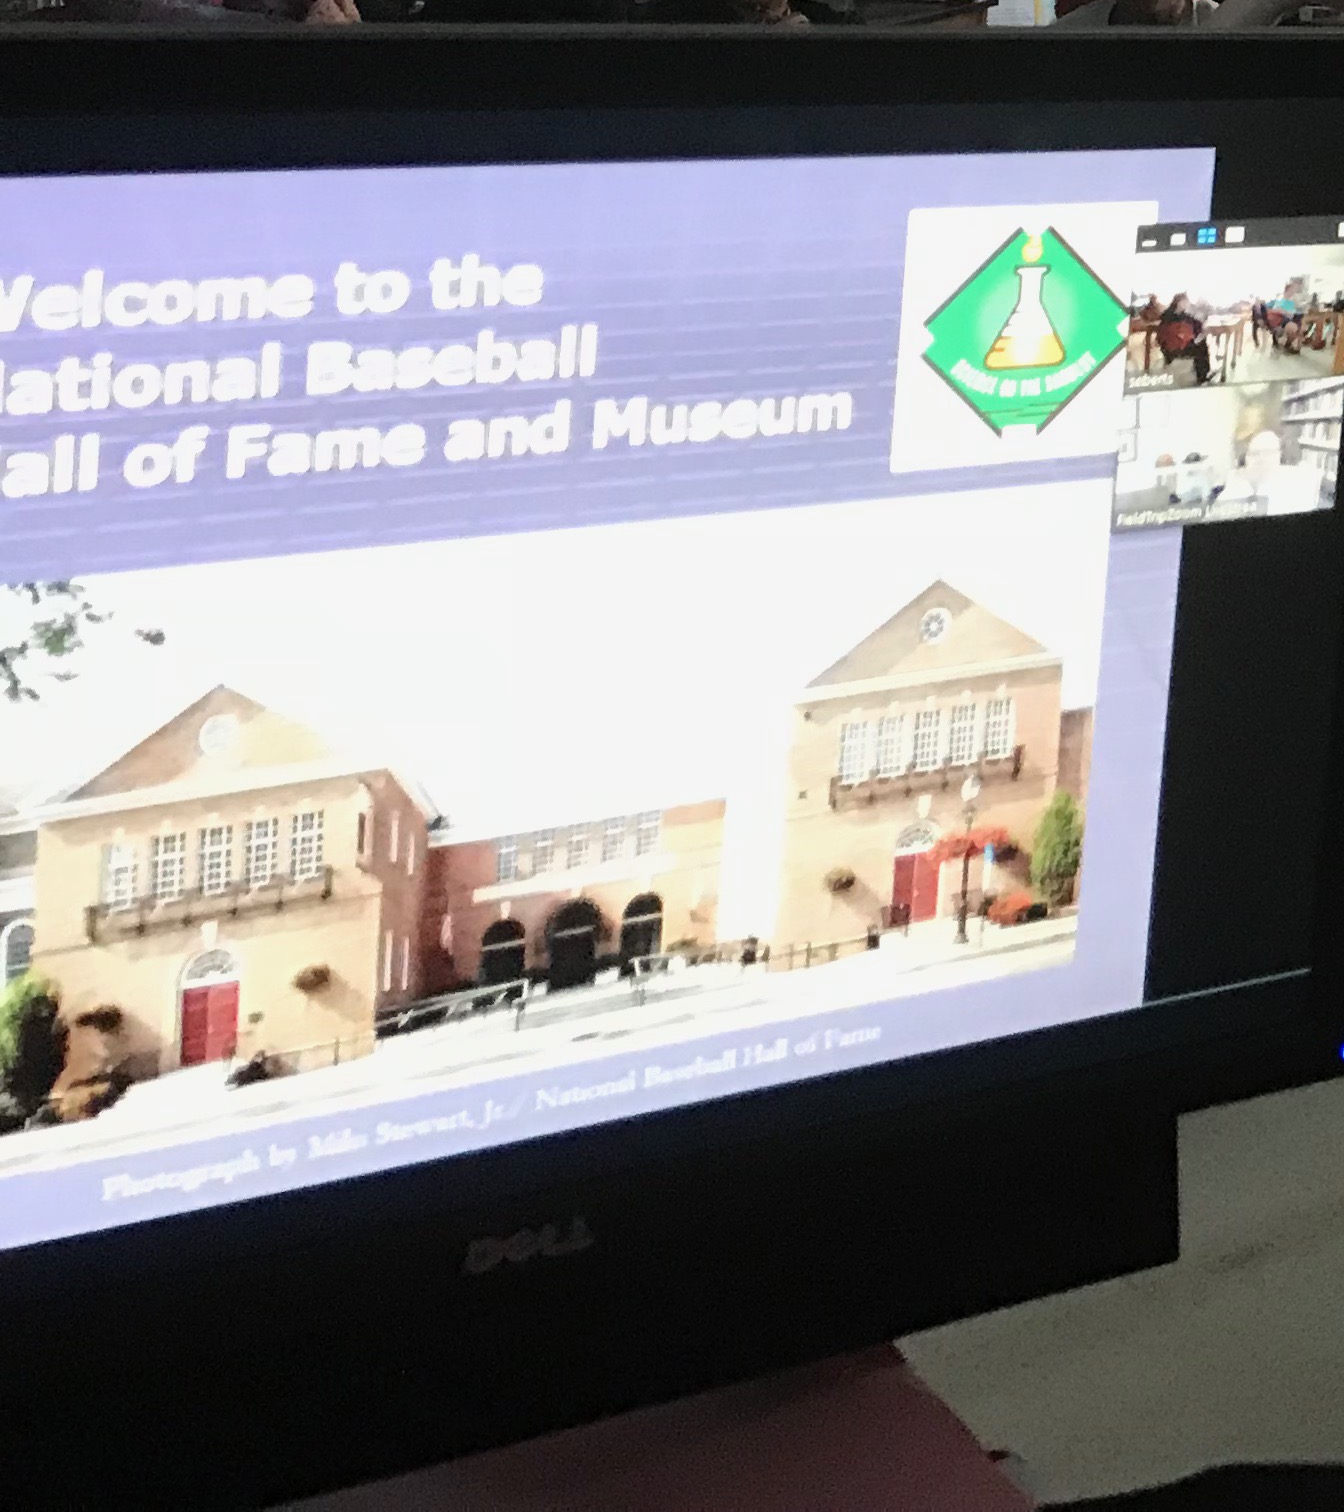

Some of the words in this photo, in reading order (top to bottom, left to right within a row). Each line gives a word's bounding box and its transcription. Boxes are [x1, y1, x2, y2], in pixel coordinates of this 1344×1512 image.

[334, 260, 412, 316] to
[429, 252, 544, 310] the
[0, 340, 283, 416] ational
[306, 322, 599, 396] Baseball
[123, 424, 212, 489] of
[225, 422, 428, 480] Fame
[443, 398, 572, 462] and
[592, 390, 854, 451] Museum
[101, 1148, 261, 1203] Photograph
[268, 1142, 297, 1171] by
[535, 1070, 637, 1112] National
[643, 1047, 737, 1090] Baseball
[743, 1037, 789, 1067] Hall
[793, 1030, 818, 1056] of
[824, 1024, 883, 1050] Fame
